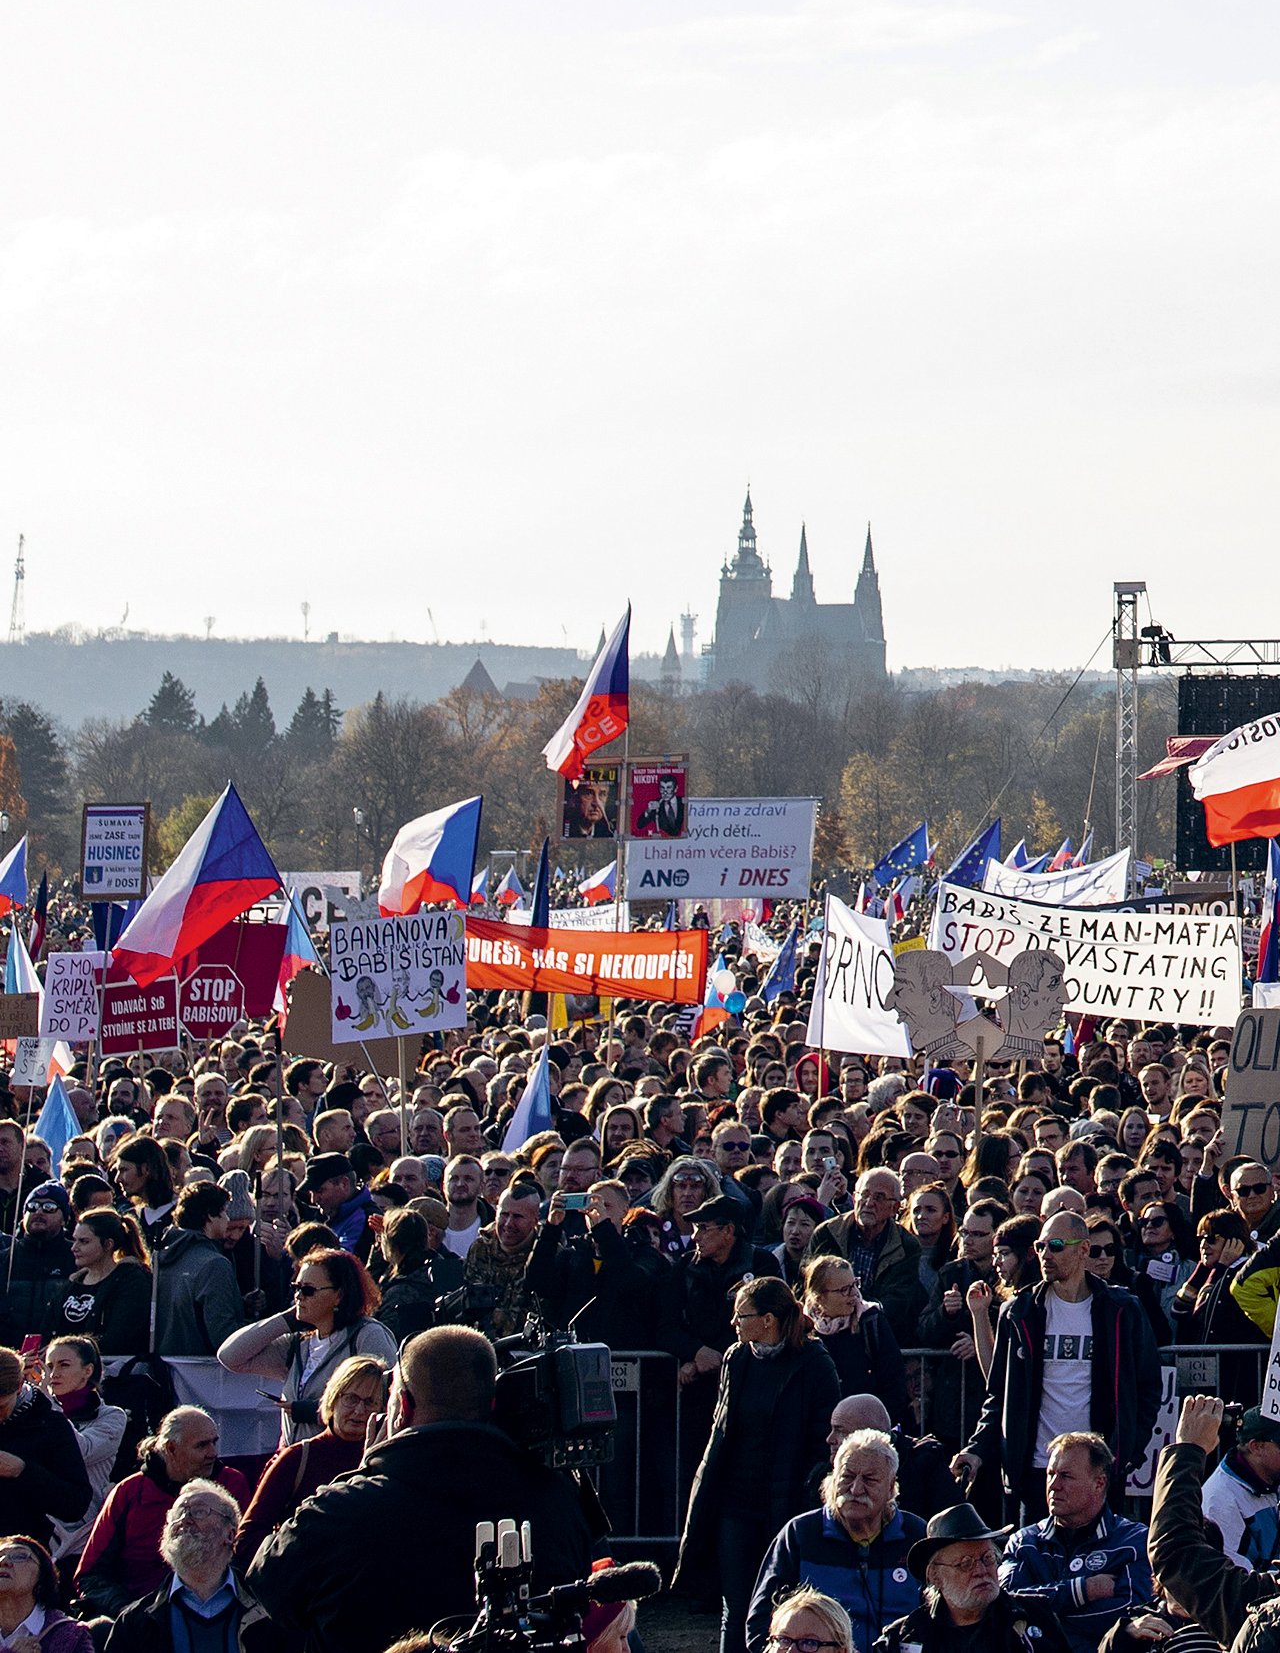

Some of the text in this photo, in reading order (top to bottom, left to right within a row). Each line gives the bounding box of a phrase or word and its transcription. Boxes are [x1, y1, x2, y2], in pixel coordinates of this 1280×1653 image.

[723, 807, 740, 817] na
[744, 803, 787, 817] zdraví
[104, 831, 126, 840] ZASE
[88, 846, 140, 860] HUSINEC
[644, 845, 797, 860] Lhal nám včera Babiš?
[115, 879, 139, 888] DOST
[720, 868, 729, 886] i
[739, 868, 791, 887] DNES
[942, 921, 1016, 956] STOP
[53, 958, 65, 975] S
[574, 953, 595, 977] SI
[599, 949, 694, 981] NEKOUPÍŠ!
[190, 978, 236, 1002] STOP
[1063, 977, 1216, 1018] OUNTRY !!
[111, 995, 165, 1016] UDAVAČI StB
[183, 1003, 238, 1023] BABIŠOVI
[48, 1017, 70, 1033] DO
[103, 1016, 176, 1039] STYDÍME SE ZA TEBE
